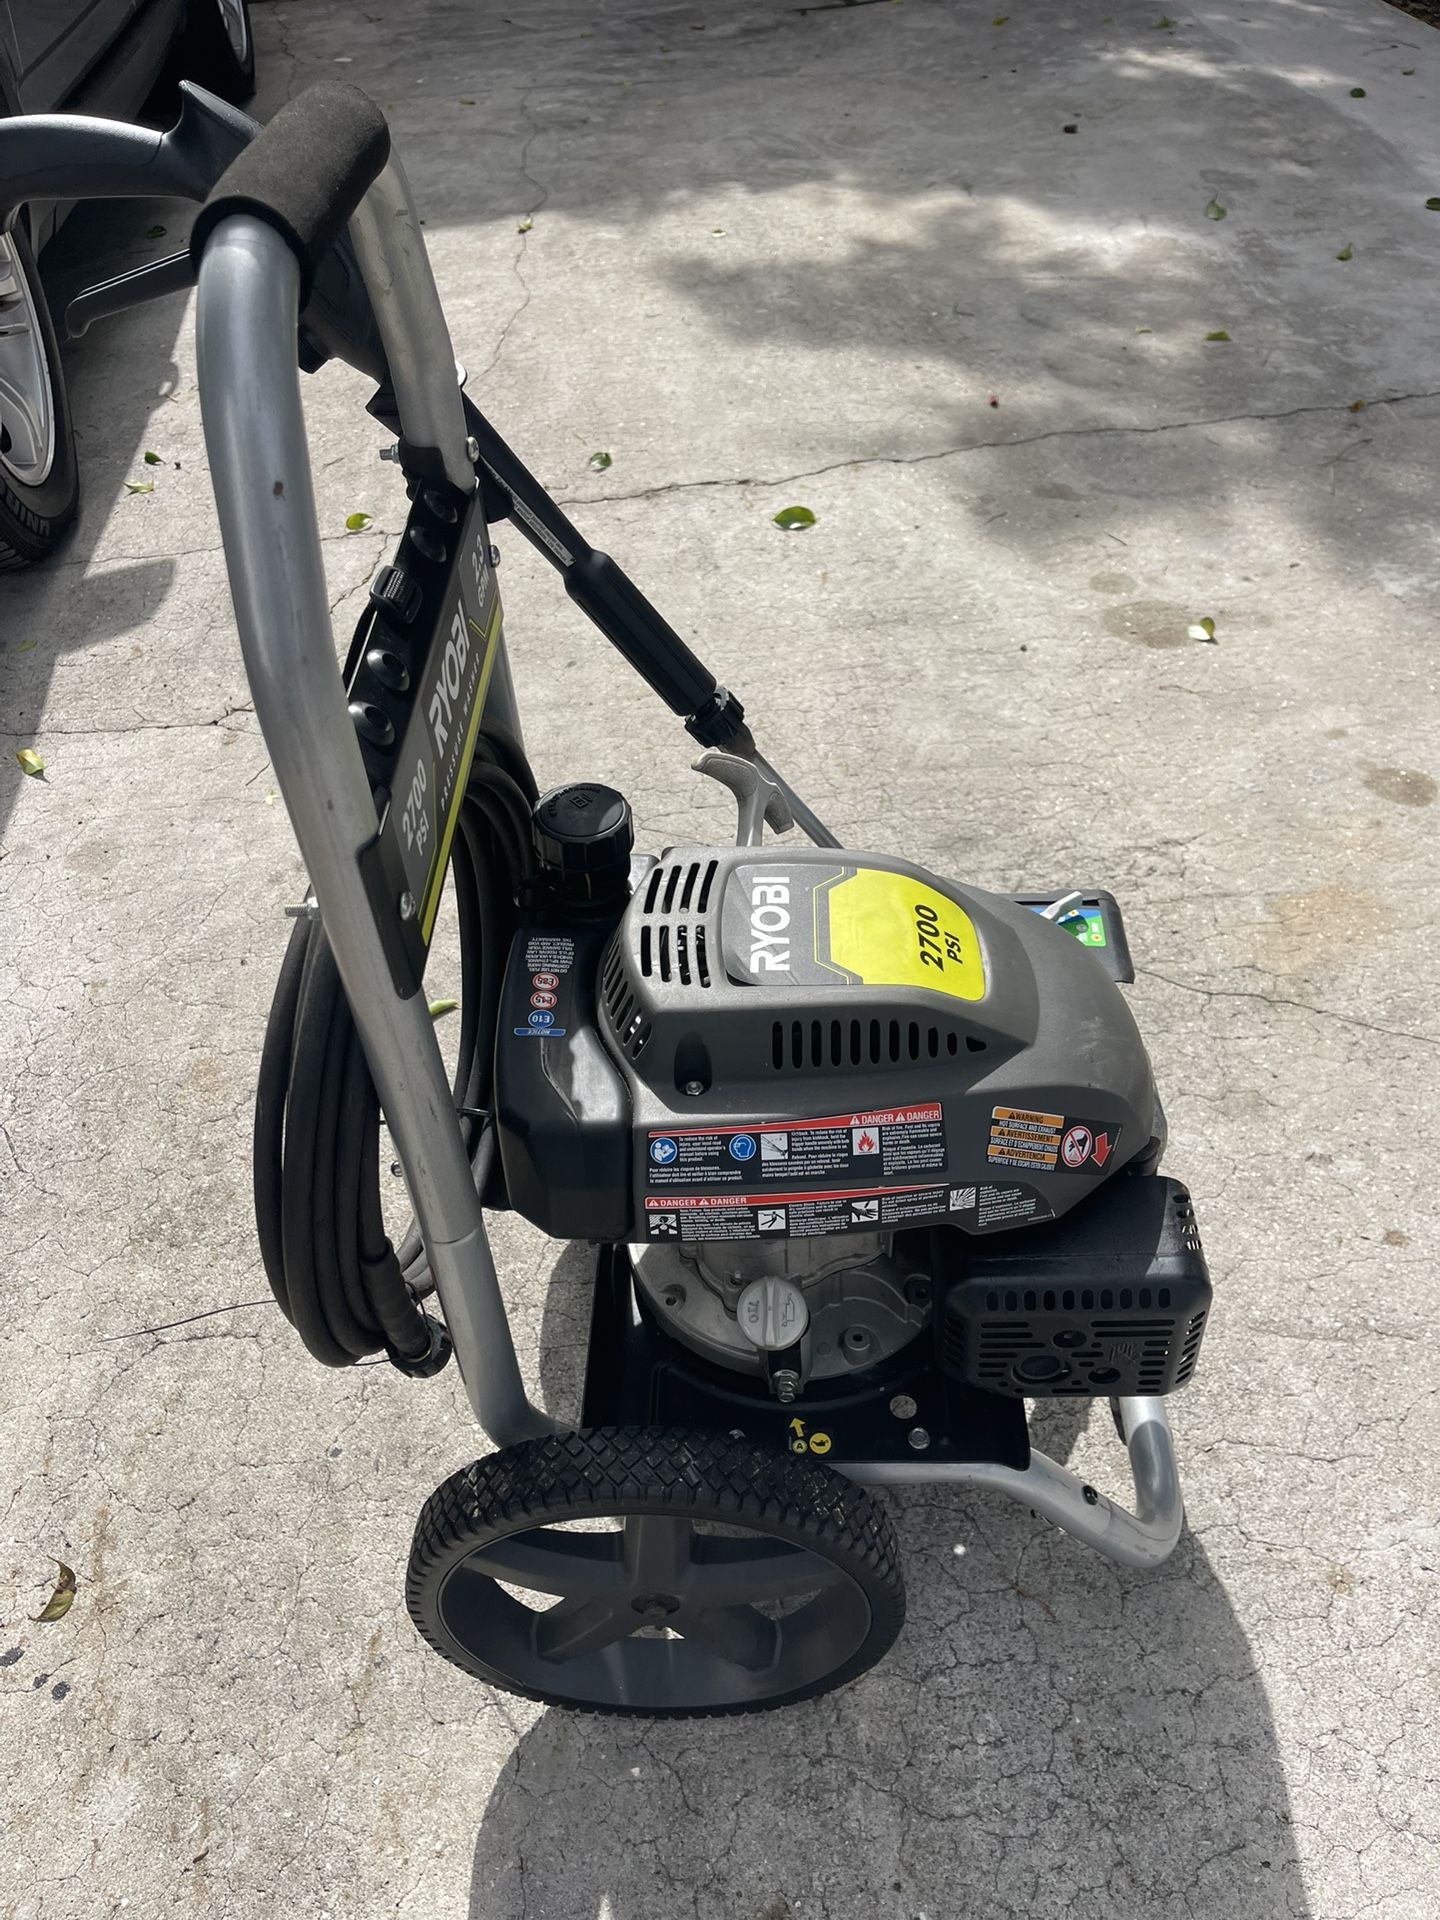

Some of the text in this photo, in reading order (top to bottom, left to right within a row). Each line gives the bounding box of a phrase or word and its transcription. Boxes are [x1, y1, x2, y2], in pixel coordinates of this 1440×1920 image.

[472, 534, 483, 584] 2.3
[478, 564, 489, 608] GPM
[428, 599, 470, 760] RYOBI
[441, 652, 480, 811] PRESSURE WASHER
[403, 759, 426, 851] 2700
[416, 809, 429, 856] PSI
[750, 876, 790, 973] RYOBI
[914, 904, 944, 972] 2700
[944, 932, 963, 965] PSI
[861, 1110, 940, 1124] DANGER DANGER
[1007, 1130, 1054, 1142] AVERTISSEMENT
[1015, 1112, 1044, 1123] WARNING
[1007, 1148, 1046, 1160] ADVERTENCIA
